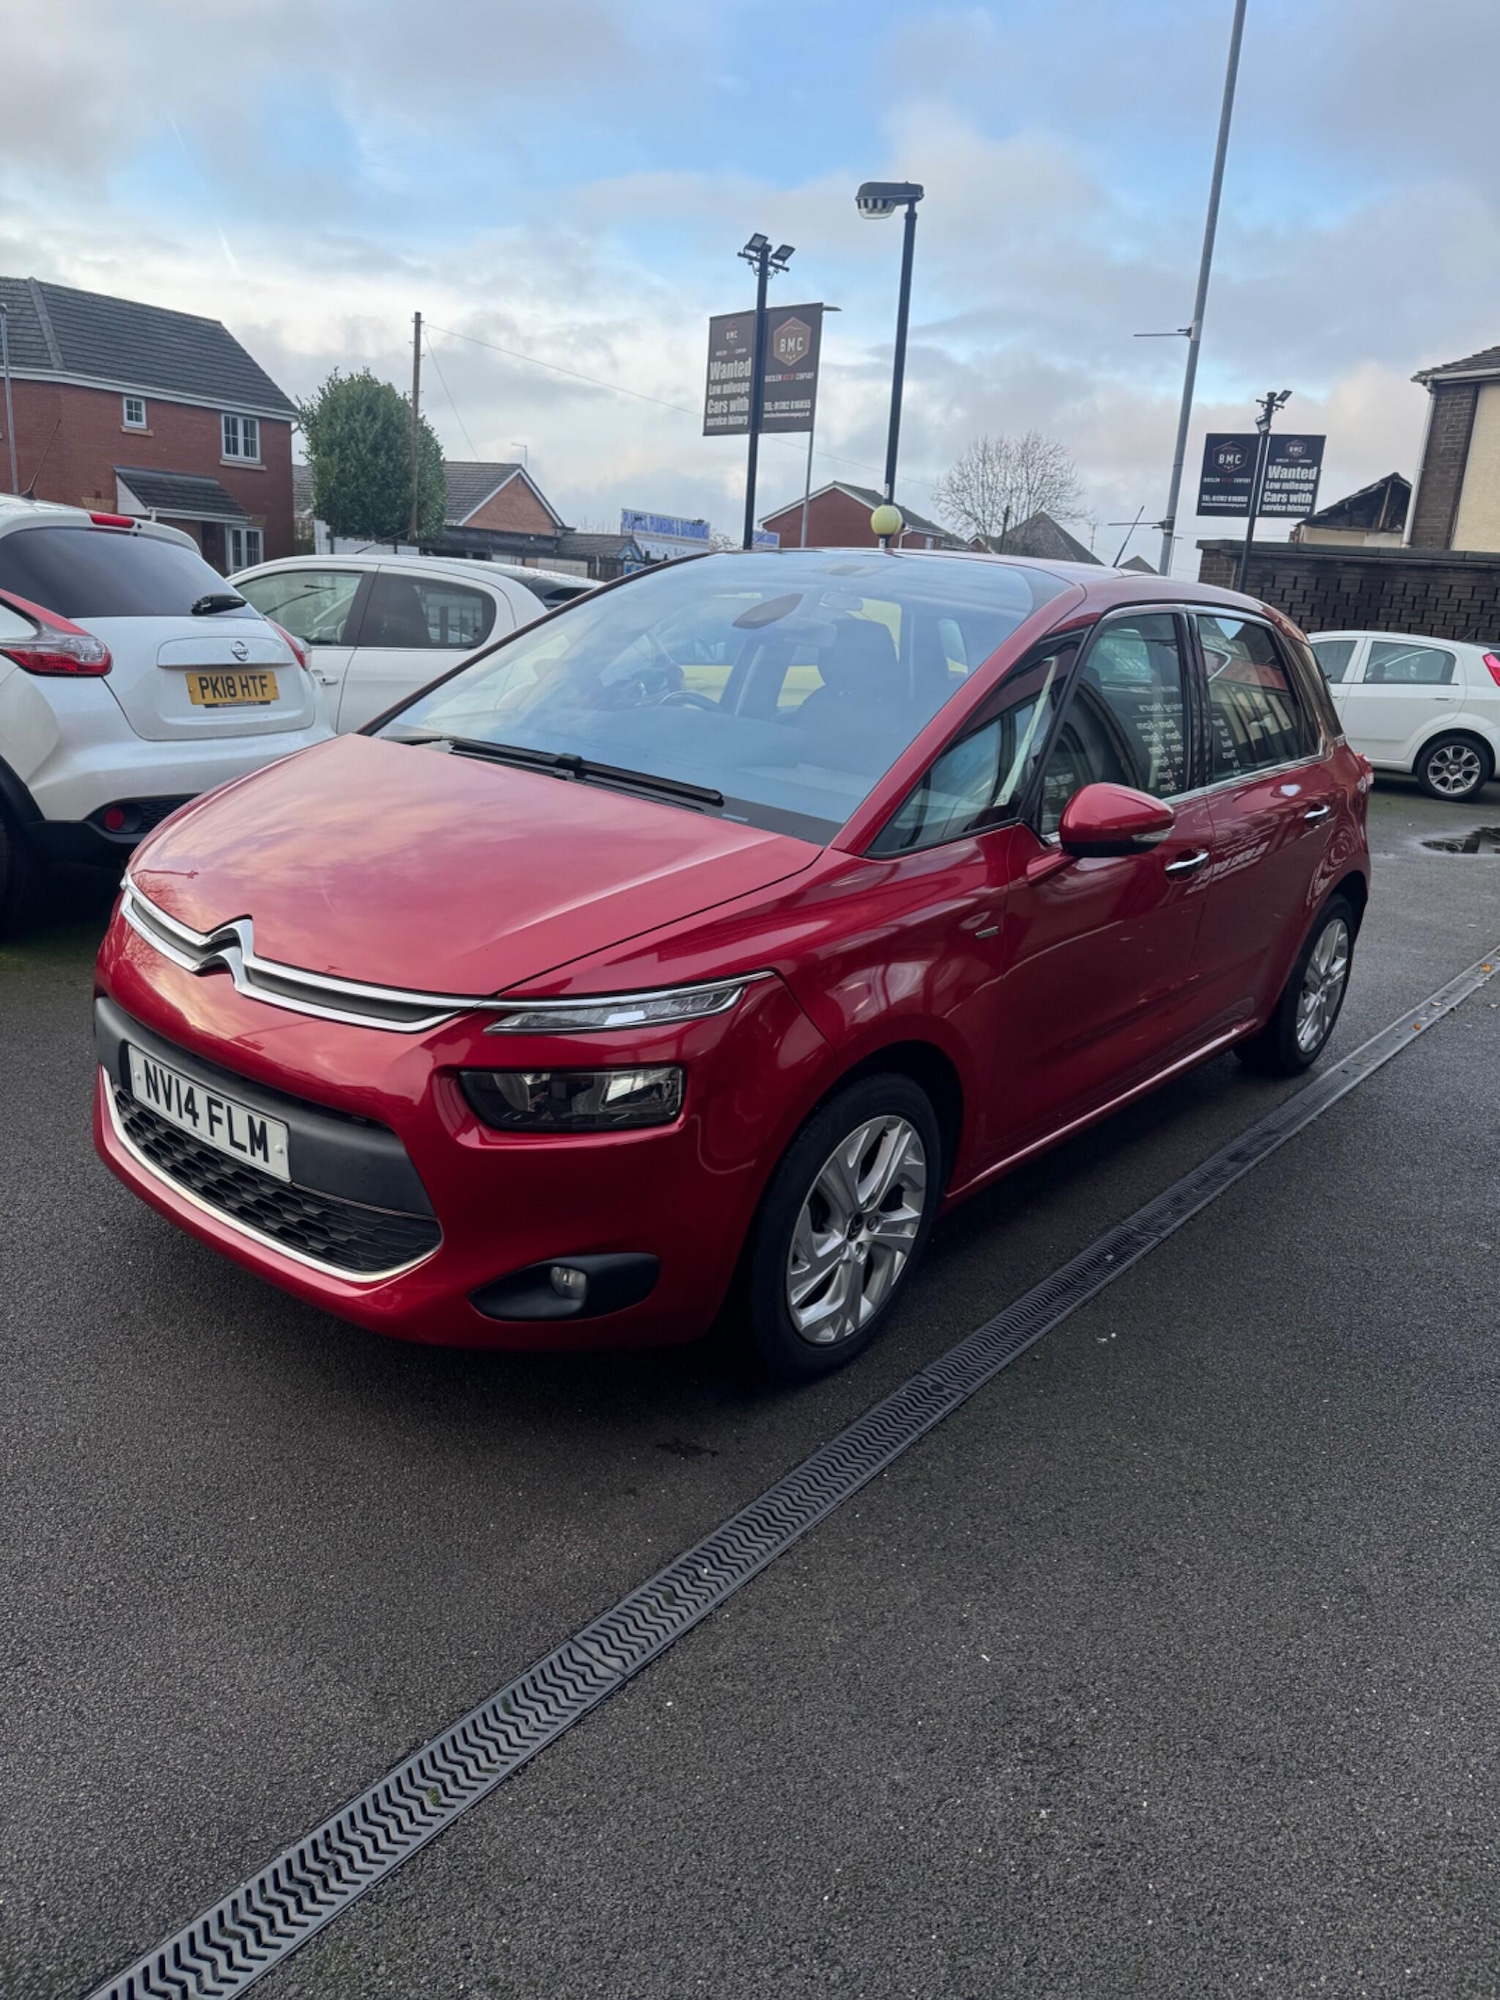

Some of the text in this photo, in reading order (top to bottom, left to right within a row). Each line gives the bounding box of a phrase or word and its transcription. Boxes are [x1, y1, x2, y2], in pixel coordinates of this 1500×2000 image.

[779, 337, 804, 353] BMC
[709, 357, 752, 381] Wanted
[708, 381, 750, 396] Low mileage
[707, 396, 749, 414] Cars with
[706, 414, 748, 427] service history
[1218, 453, 1242, 465] BMC
[1267, 465, 1318, 480] Wanted
[1265, 480, 1314, 492] Low mileage
[1263, 491, 1313, 504] Cars with
[1261, 503, 1311, 513] service history
[198, 674, 268, 700] PK18 HTF
[143, 1058, 270, 1164] NV14 FLM
